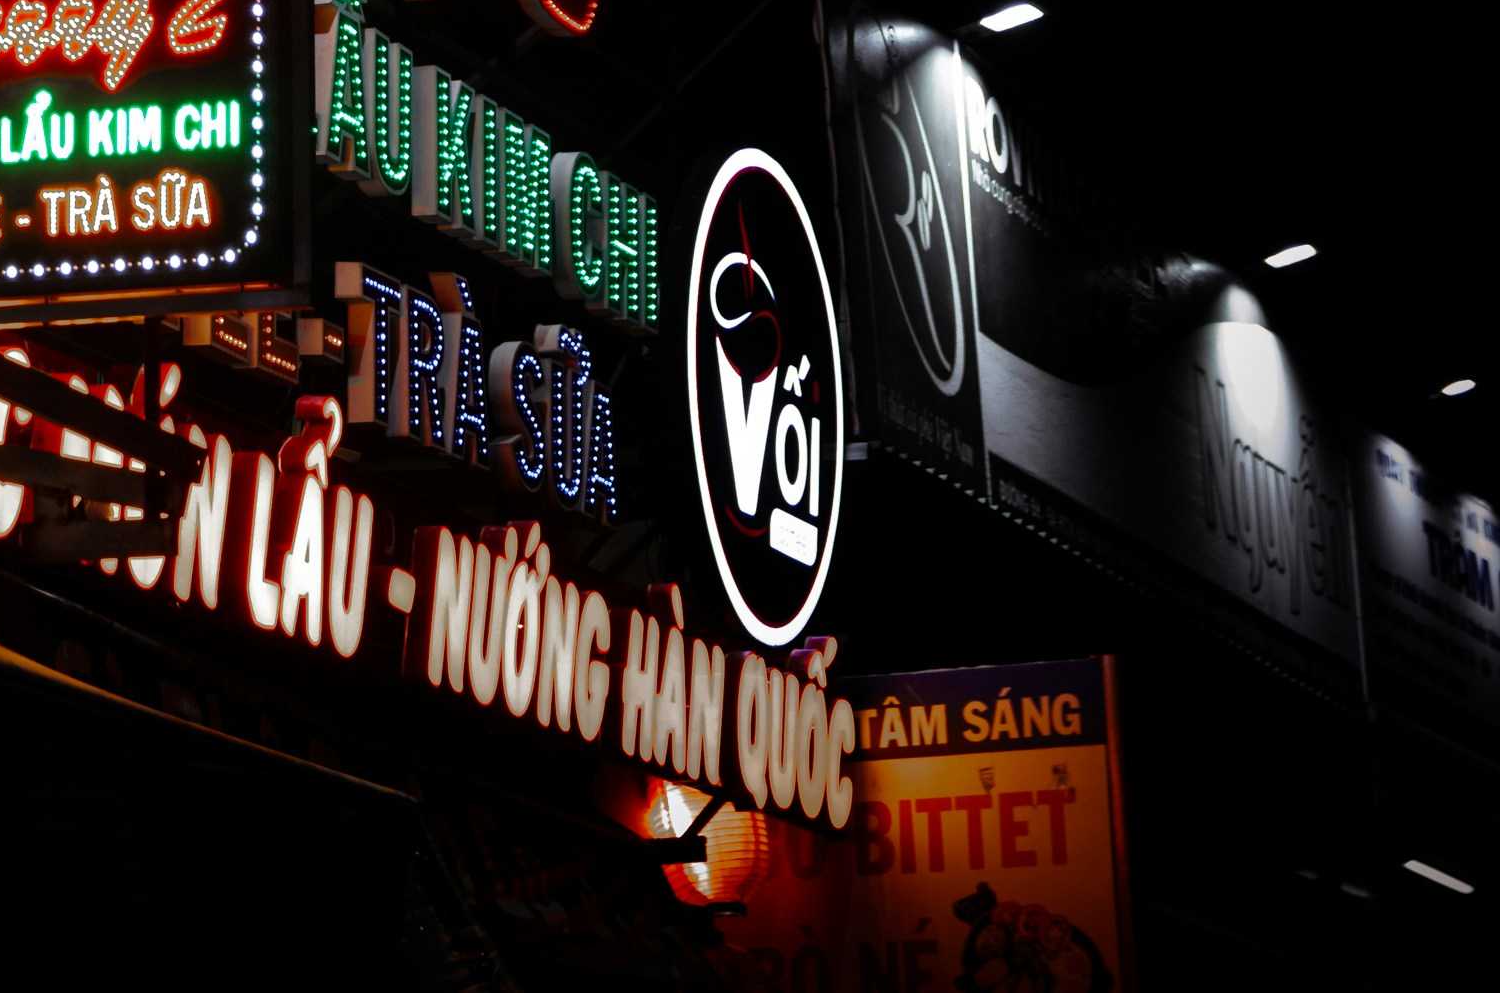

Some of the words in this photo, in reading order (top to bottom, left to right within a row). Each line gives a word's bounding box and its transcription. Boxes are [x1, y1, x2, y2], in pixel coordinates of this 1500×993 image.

[88, 105, 163, 158] KIM
[173, 101, 241, 151] CHI
[41, 174, 119, 236] TRÀ
[131, 169, 212, 231] SỮA
[418, 64, 554, 278] KIM
[553, 151, 660, 336] CHI
[338, 262, 491, 471] TRÀ
[426, 520, 611, 742] NƯỚNG
[621, 582, 726, 787] HÀN
[737, 635, 856, 830] QUỐC
[857, 695, 949, 750] TÂM
[961, 686, 1083, 744] SÁNG
